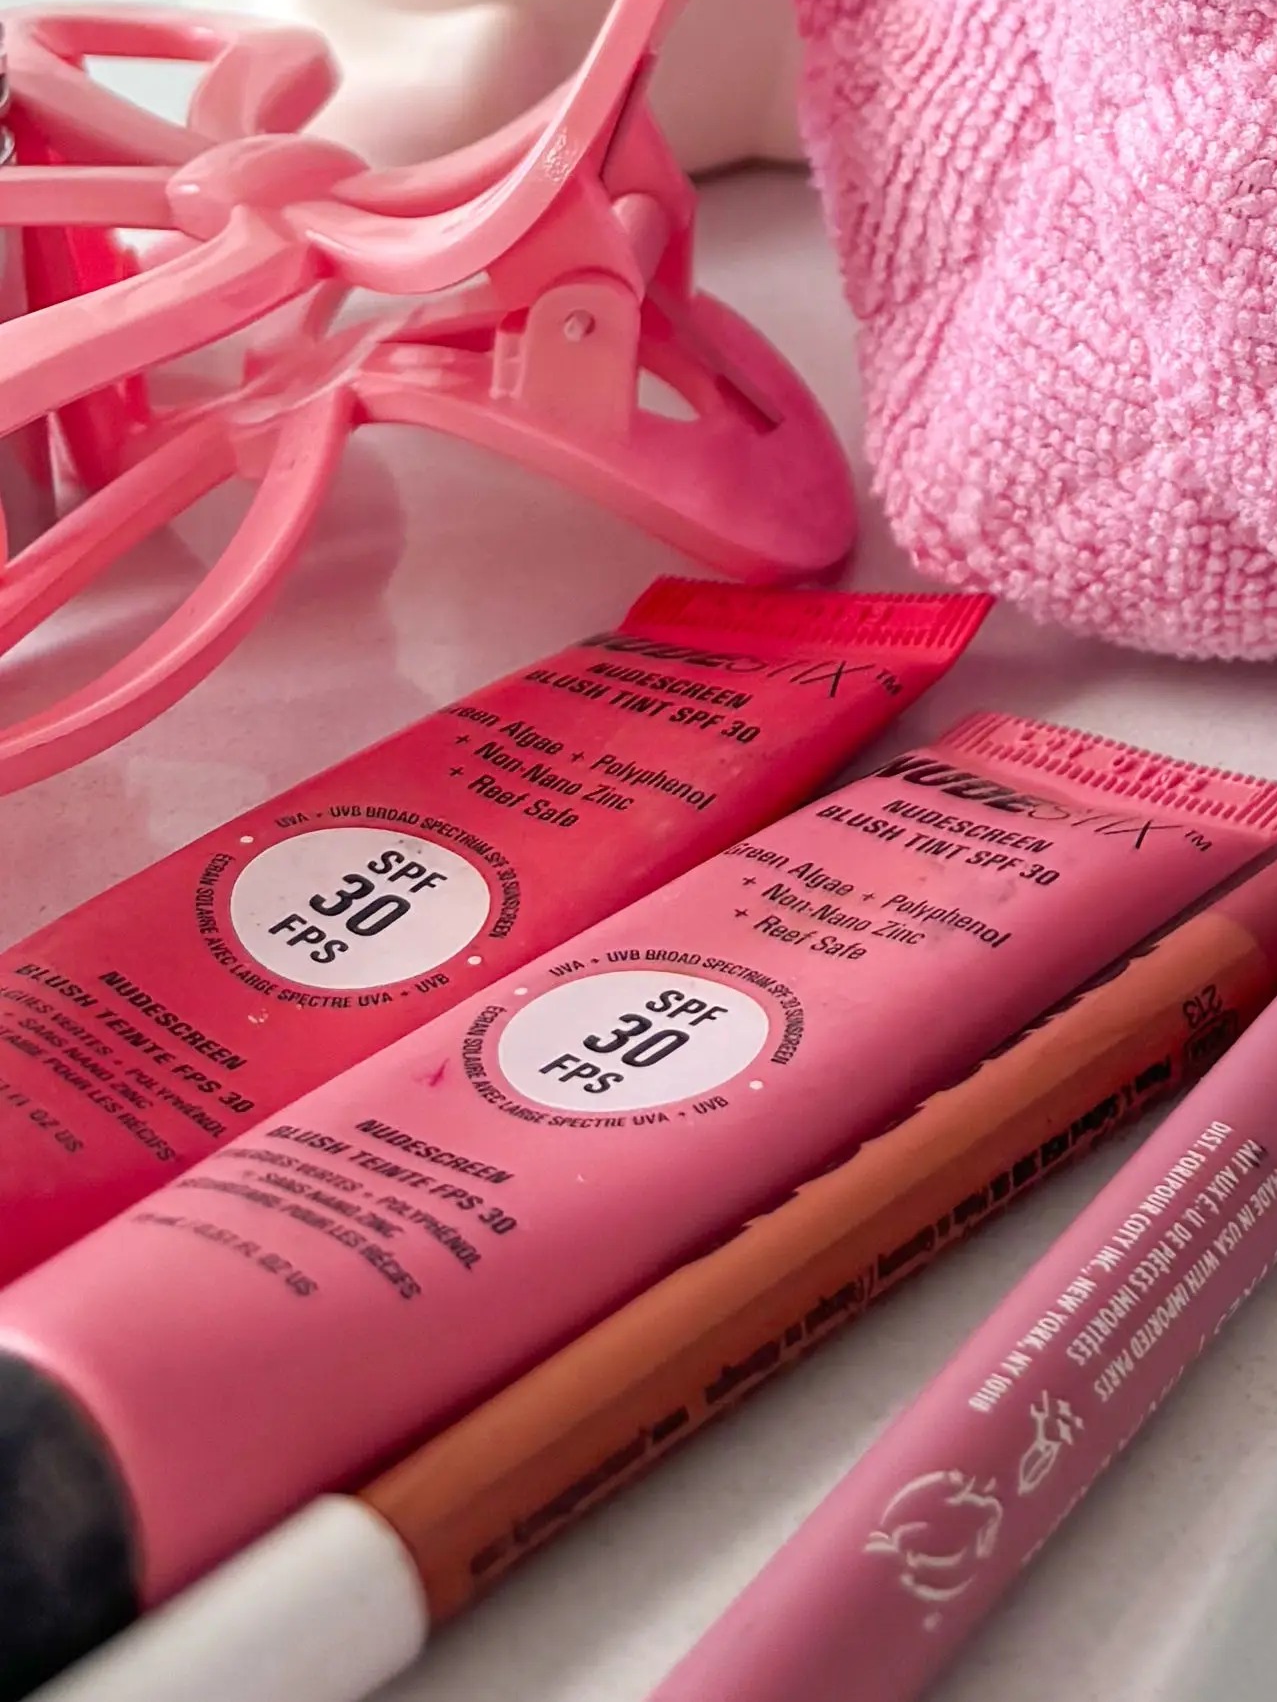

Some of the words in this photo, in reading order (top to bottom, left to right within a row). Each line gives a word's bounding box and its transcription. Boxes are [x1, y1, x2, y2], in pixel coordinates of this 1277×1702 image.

[525, 668, 607, 714] BLUSH
[610, 688, 668, 725] TINT
[669, 705, 726, 739] SPF
[720, 719, 762, 746] 30
[586, 661, 755, 710] NUDESCREEN
[474, 740, 583, 799] Non-Nano
[582, 780, 635, 812] Zinc
[499, 719, 564, 759] Algae
[591, 753, 718, 813] Polyphenol
[467, 774, 529, 810] Reef
[523, 798, 580, 829] Safe
[816, 804, 907, 852] BLUSH
[904, 830, 966, 867] TINT
[965, 847, 1026, 877] SPF
[1020, 860, 1061, 887] 30
[881, 799, 1055, 854] NUDESCREEN
[367, 850, 449, 893] SPF
[309, 874, 412, 937] 30
[761, 882, 872, 936] Non-Nano
[870, 918, 926, 948] Zinc
[787, 860, 855, 898] Algae
[884, 893, 1012, 950] Polyphenol
[268, 913, 349, 964] FPS
[752, 915, 812, 953] Reef
[807, 934, 867, 962] Safe
[358, 992, 394, 1009] UVA
[414, 972, 451, 995] UVB
[548, 959, 586, 978] UVA
[606, 949, 641, 964] UVB
[644, 949, 702, 965] BROAD
[701, 957, 778, 991] SPECTRUM
[98, 970, 248, 1072] NUDESCREEN
[645, 988, 729, 1027] SPF
[1182, 983, 1223, 1030] 213
[15, 962, 99, 1009] BLUSH
[95, 1007, 177, 1065] TEINTE
[171, 1063, 223, 1095] FPS
[218, 1091, 256, 1115] 30
[582, 1013, 691, 1068] 30
[538, 1053, 625, 1094] FPS
[632, 1111, 670, 1126] UVA
[692, 1094, 729, 1116] UVB
[355, 1118, 515, 1186] NUDESCREEN
[1193, 1120, 1236, 1153] DIST.
[265, 1124, 350, 1156] BLUSH
[348, 1149, 433, 1189] TEINTE
[429, 1182, 485, 1212] FPS
[477, 1206, 518, 1236] 30
[1205, 1165, 1241, 1202] AUX
[1111, 1212, 1152, 1250] COTY
[1164, 1221, 1194, 1250] DE
[1213, 1220, 1245, 1258] USA
[1236, 1203, 1257, 1233] IN
[1056, 1275, 1098, 1315] NEW
[1181, 1248, 1221, 1296] WITH
[1016, 1309, 1069, 1352] YORK,
[1065, 1283, 1142, 1367] IMPORTÉES
[1130, 1261, 1191, 1360] IMPORTED
[1000, 1349, 1033, 1379] NY
[1094, 1347, 1136, 1403] PARTS
